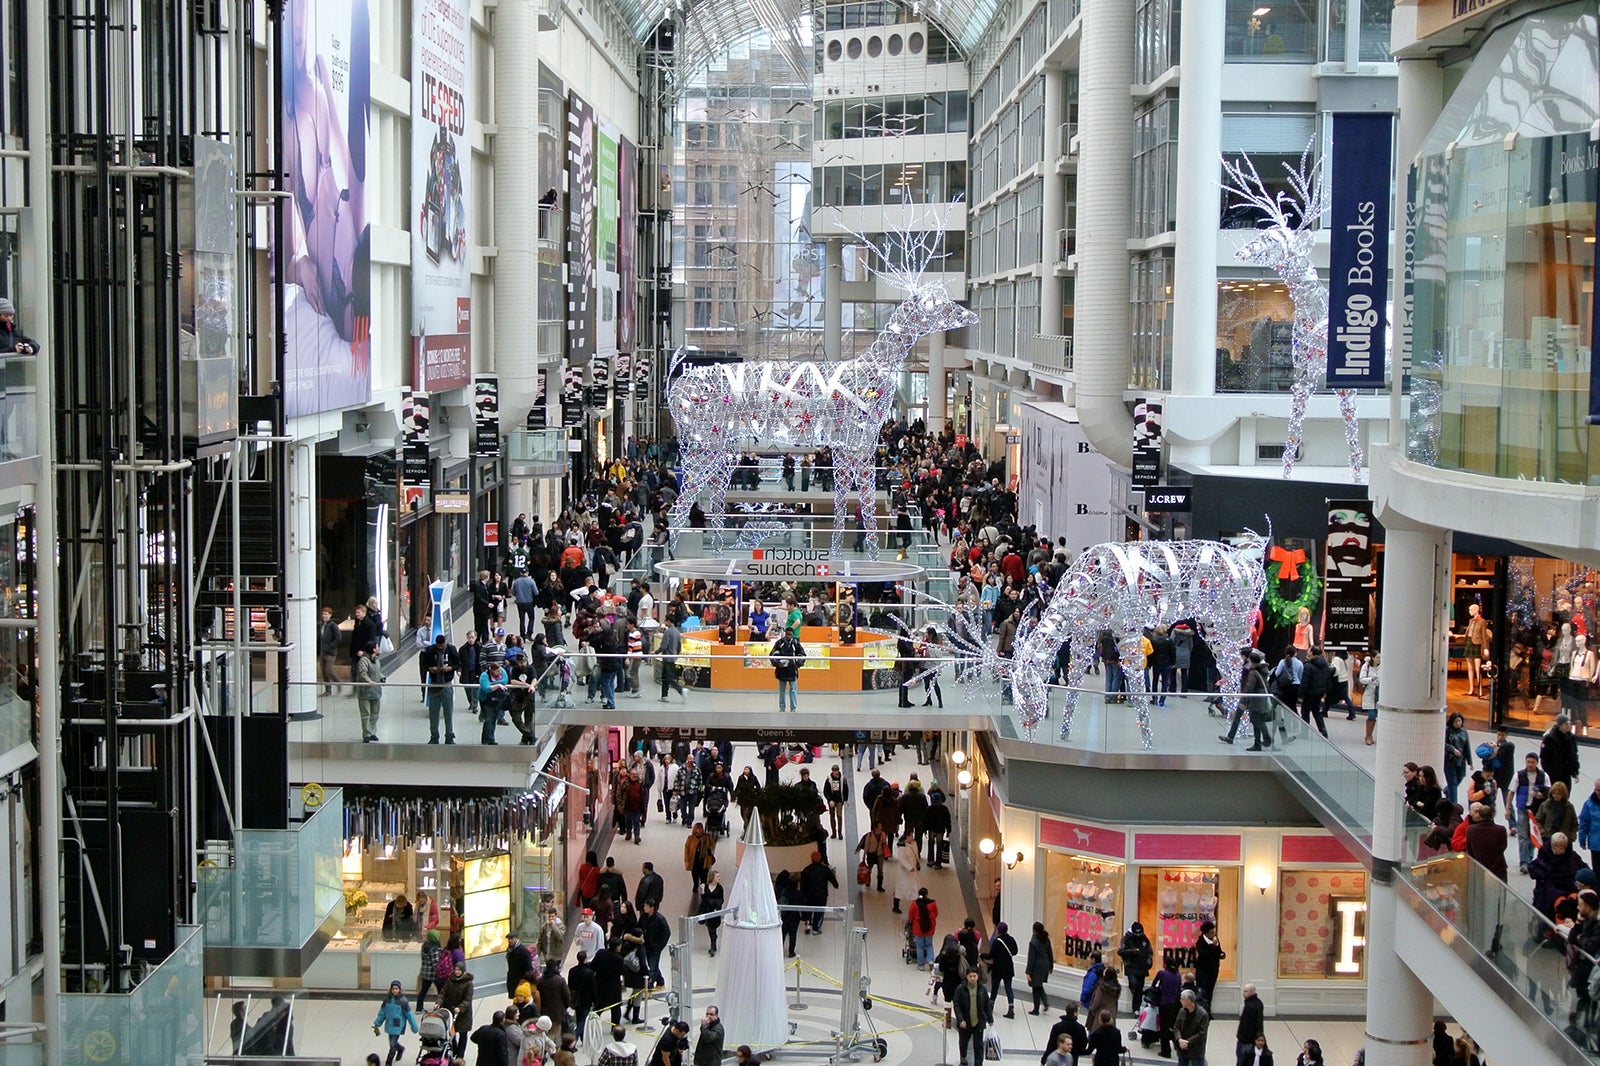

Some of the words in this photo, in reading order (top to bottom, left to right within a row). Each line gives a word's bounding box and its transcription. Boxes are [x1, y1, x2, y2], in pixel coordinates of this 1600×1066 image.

[421, 70, 437, 123] LTE
[437, 80, 465, 137] SPEED
[1560, 148, 1585, 175] Books
[1346, 201, 1375, 286] Books
[1335, 294, 1378, 376] Indigo
[1148, 494, 1186, 504] J.CREW
[514, 555, 526, 568] 12
[747, 562, 815, 576] swatch
[757, 729, 784, 737] Queen
[785, 729, 797, 737] St.
[1065, 908, 1104, 939] 50%
